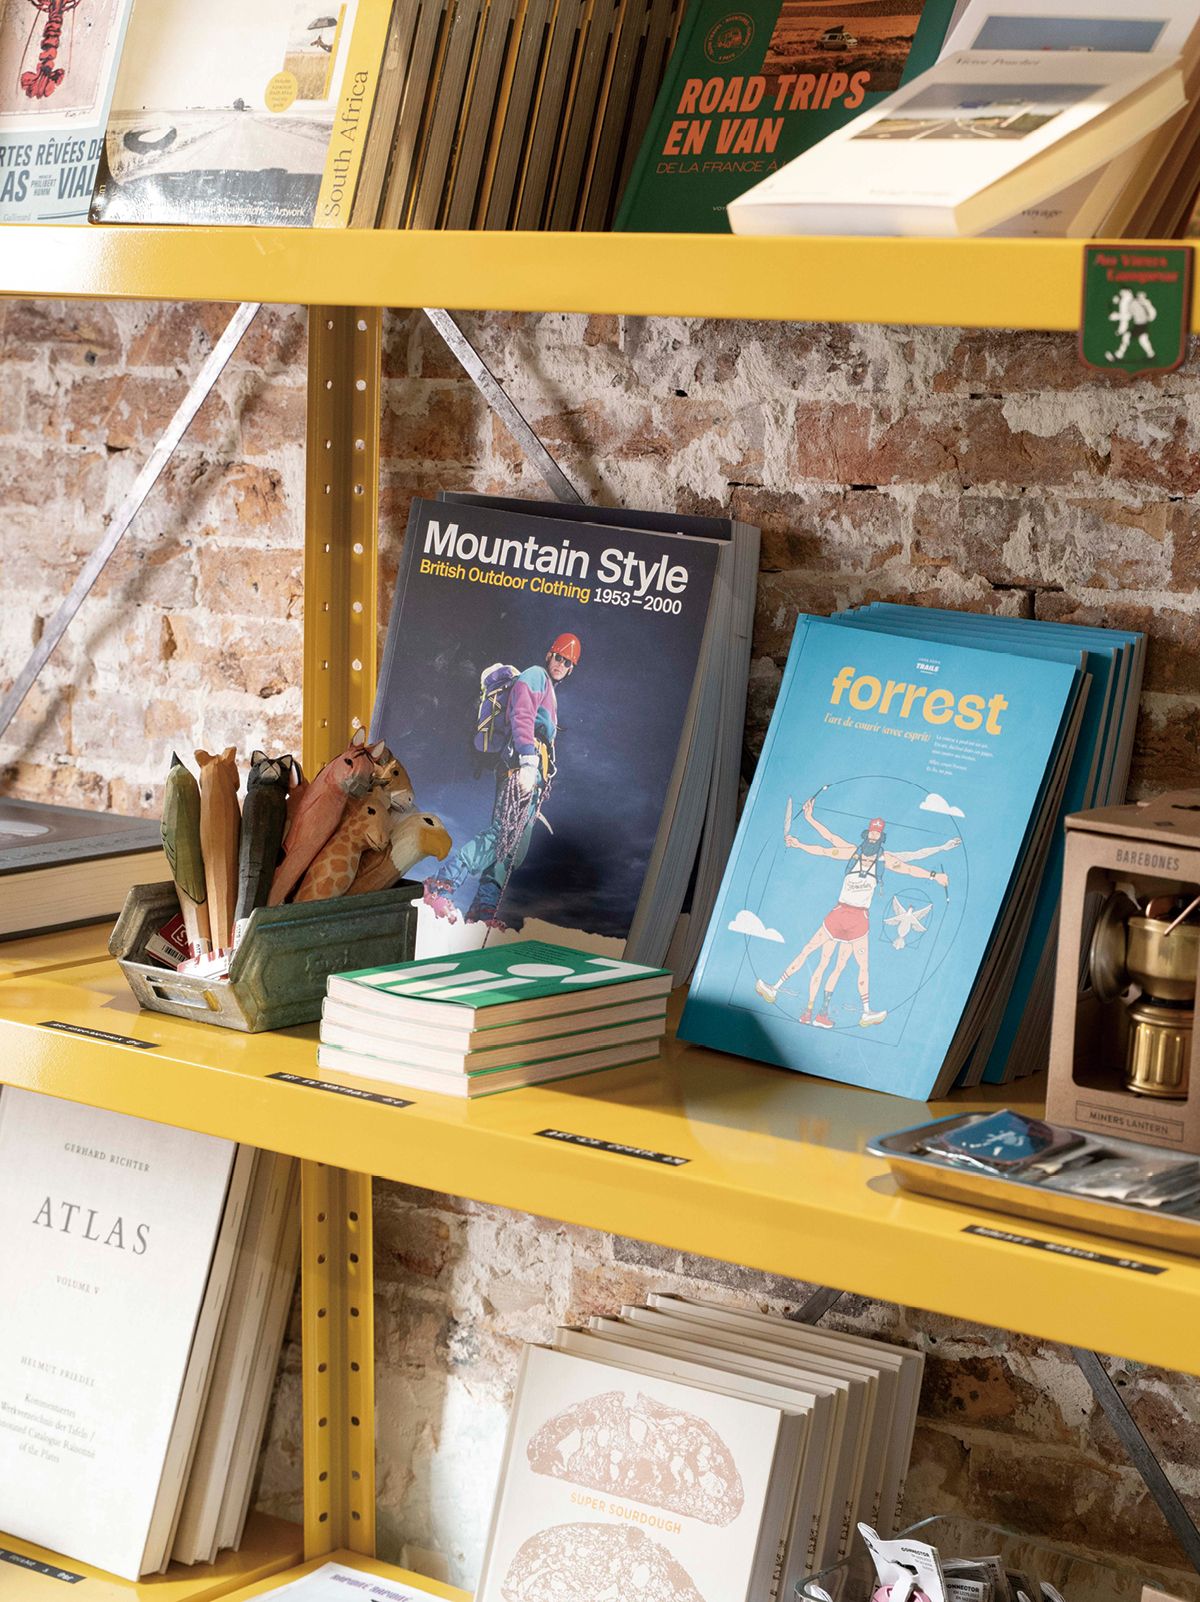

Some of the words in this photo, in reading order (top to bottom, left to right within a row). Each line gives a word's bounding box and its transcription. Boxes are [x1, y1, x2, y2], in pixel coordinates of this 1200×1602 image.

[676, 76, 766, 114] ROAD
[774, 71, 871, 111] TRIPS
[35, 136, 86, 166] RÊVÉES
[324, 149, 352, 217] South
[340, 71, 368, 142] Africa
[662, 119, 712, 156] EN
[715, 117, 784, 154] VAN
[656, 162, 678, 174] DE
[678, 161, 699, 173] LA
[701, 160, 764, 173] FRANCE
[423, 520, 590, 579] Mountain
[597, 548, 689, 597] Style
[420, 559, 466, 580] British
[468, 567, 528, 590] Outdoor
[529, 577, 591, 604] Clothing
[830, 666, 1008, 735] forrest
[854, 721, 881, 733] courir
[1116, 849, 1180, 871] BAREBONES
[1089, 1111, 1124, 1126] MINERS
[1126, 1120, 1169, 1135] LANTERN
[64, 1142, 106, 1161] GERHARD
[109, 1154, 151, 1172] RICHTER
[32, 1196, 151, 1255] ATLAS
[21, 1356, 58, 1376] HELMUT
[570, 1491, 606, 1512] SUPER
[609, 1503, 682, 1535] SOURDOUGH
